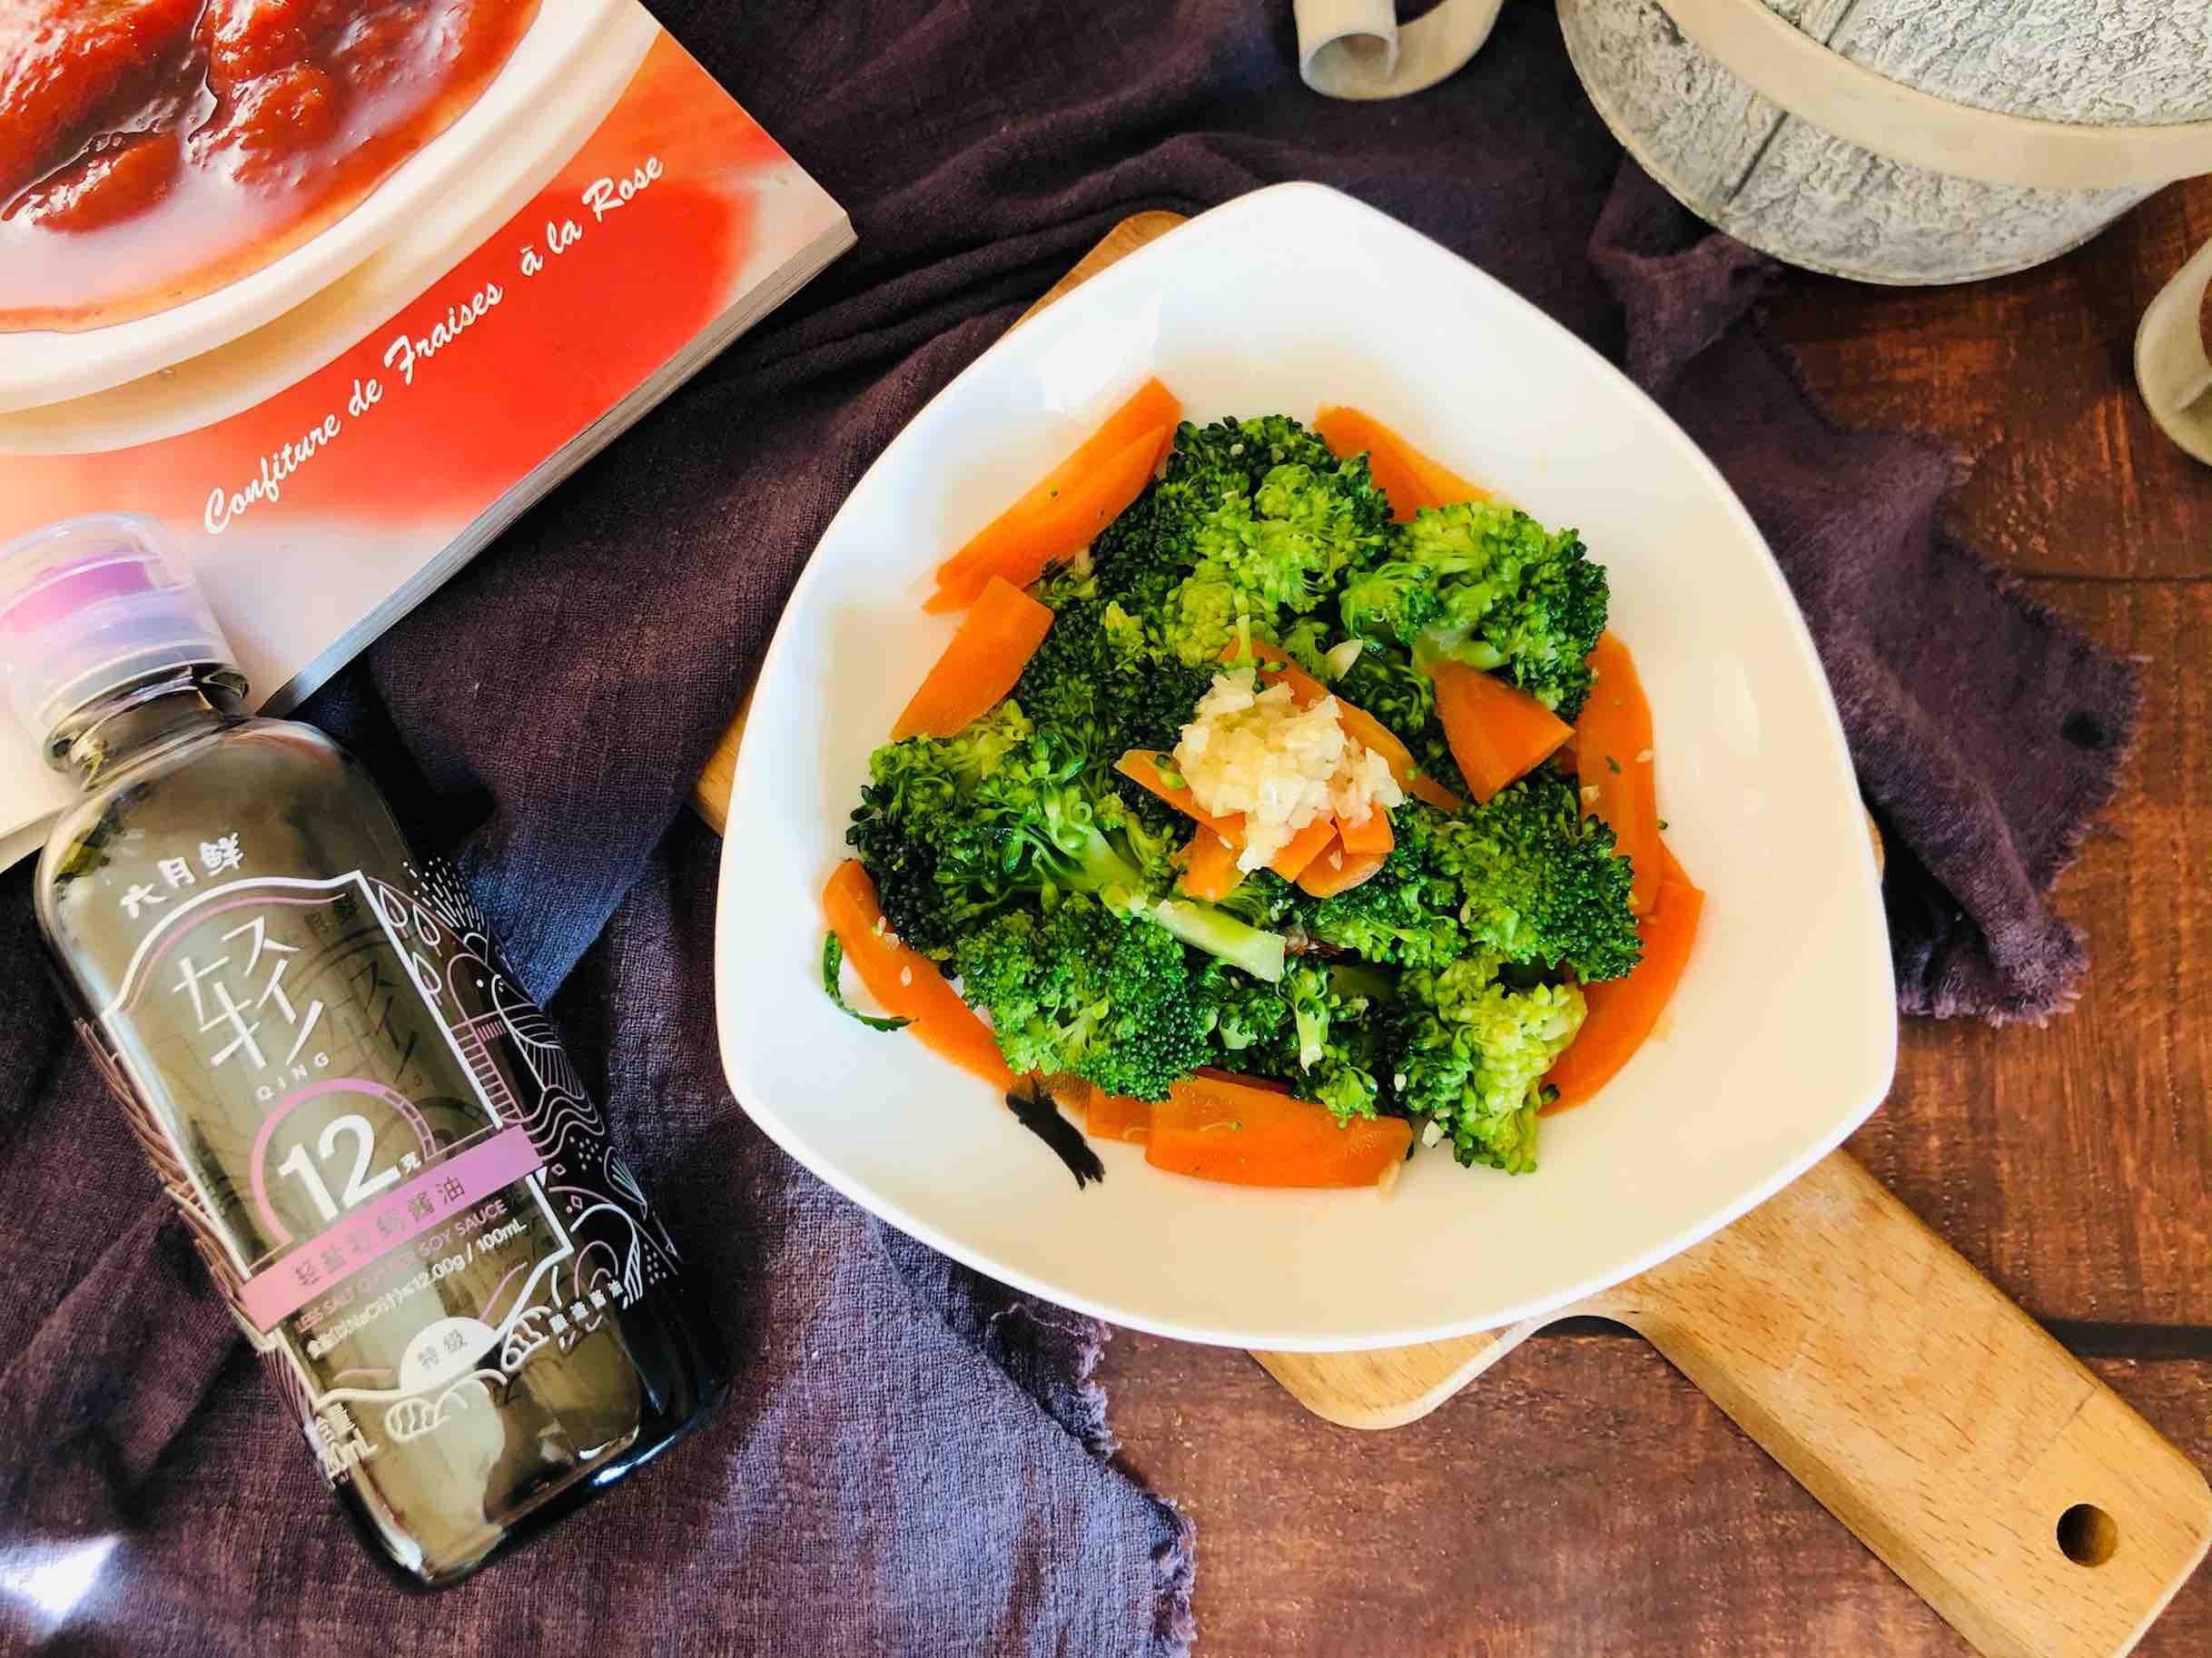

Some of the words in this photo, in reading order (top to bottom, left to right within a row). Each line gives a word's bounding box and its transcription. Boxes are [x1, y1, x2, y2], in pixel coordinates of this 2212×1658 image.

[202, 415, 341, 535] Confiture
[348, 377, 383, 418] de
[383, 283, 505, 383] Fraises
[546, 220, 584, 255] la
[582, 155, 665, 222] Rose
[256, 1051, 330, 1101] QING
[418, 1229, 452, 1258] SOY
[456, 1198, 508, 1237] SAUCE
[476, 1217, 528, 1252] 100mL
